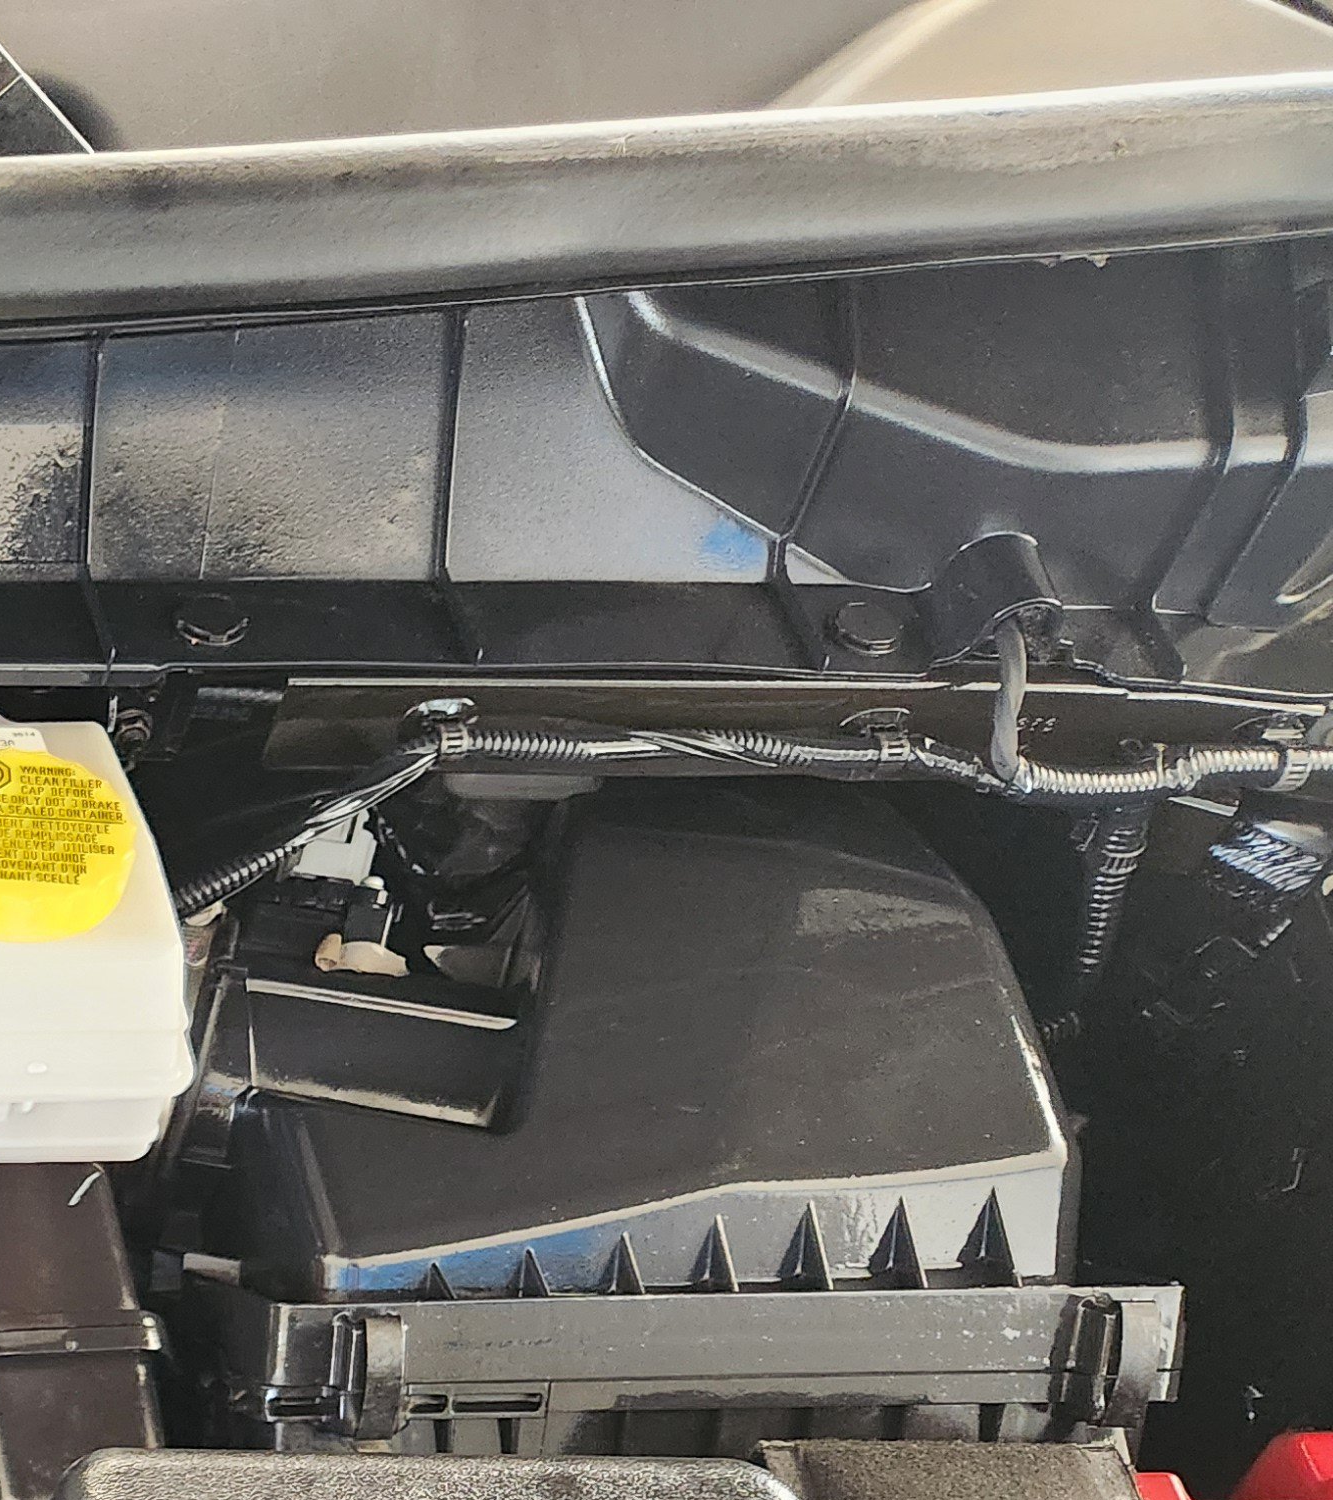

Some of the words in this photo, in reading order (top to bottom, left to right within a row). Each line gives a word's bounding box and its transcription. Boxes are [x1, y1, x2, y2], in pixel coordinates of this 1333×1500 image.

[19, 765, 76, 777] WARNING:
[20, 775, 59, 787] CLEAN
[62, 777, 103, 789] FILLER
[21, 785, 44, 795] CAP
[51, 787, 94, 799] BEFORE
[11, 795, 41, 806] ONLY
[45, 797, 65, 808] DOT
[71, 799, 78, 808] 3
[82, 800, 121, 812] BRAKE
[8, 805, 54, 817] SEALED
[32, 820, 93, 834] NETTOYER
[97, 825, 110, 835] LE
[15, 830, 98, 844] REMPLISSAGE
[63, 843, 115, 856] UTILISER
[23, 850, 37, 860] DU
[42, 852, 86, 864] LIQUIDE
